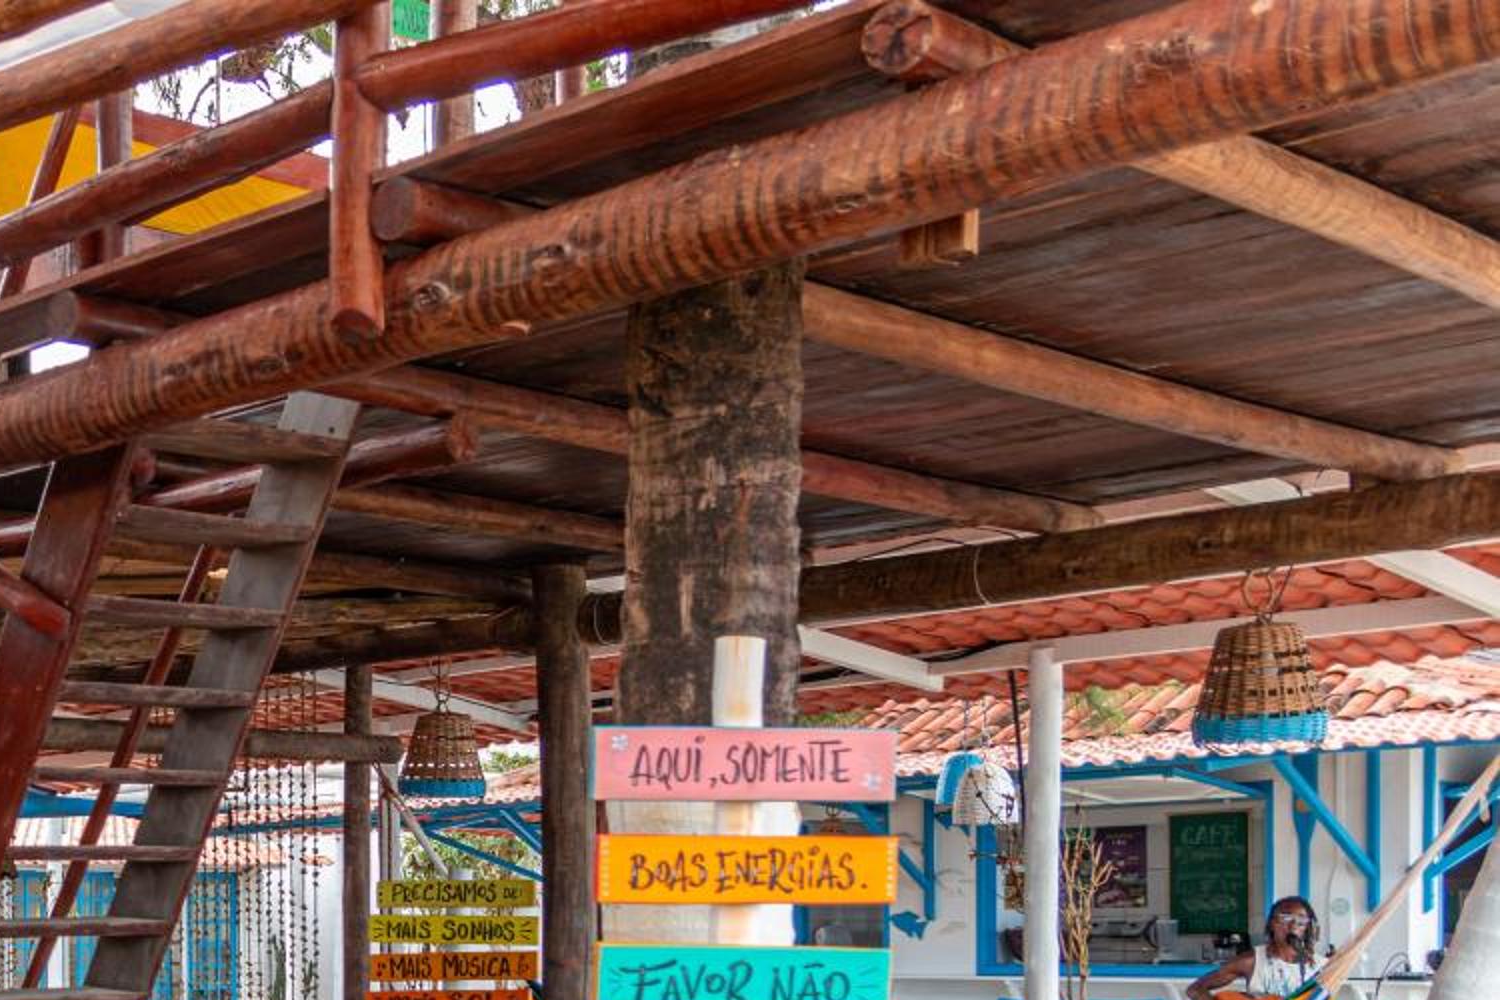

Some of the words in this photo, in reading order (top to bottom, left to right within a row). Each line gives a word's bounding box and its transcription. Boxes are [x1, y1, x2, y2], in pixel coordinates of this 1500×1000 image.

[720, 740, 853, 784] SOMENTE
[628, 849, 708, 891] BOAS
[391, 883, 497, 903] PRECISAMOS
[441, 919, 516, 942] SONHOS
[389, 956, 433, 979] MAIS
